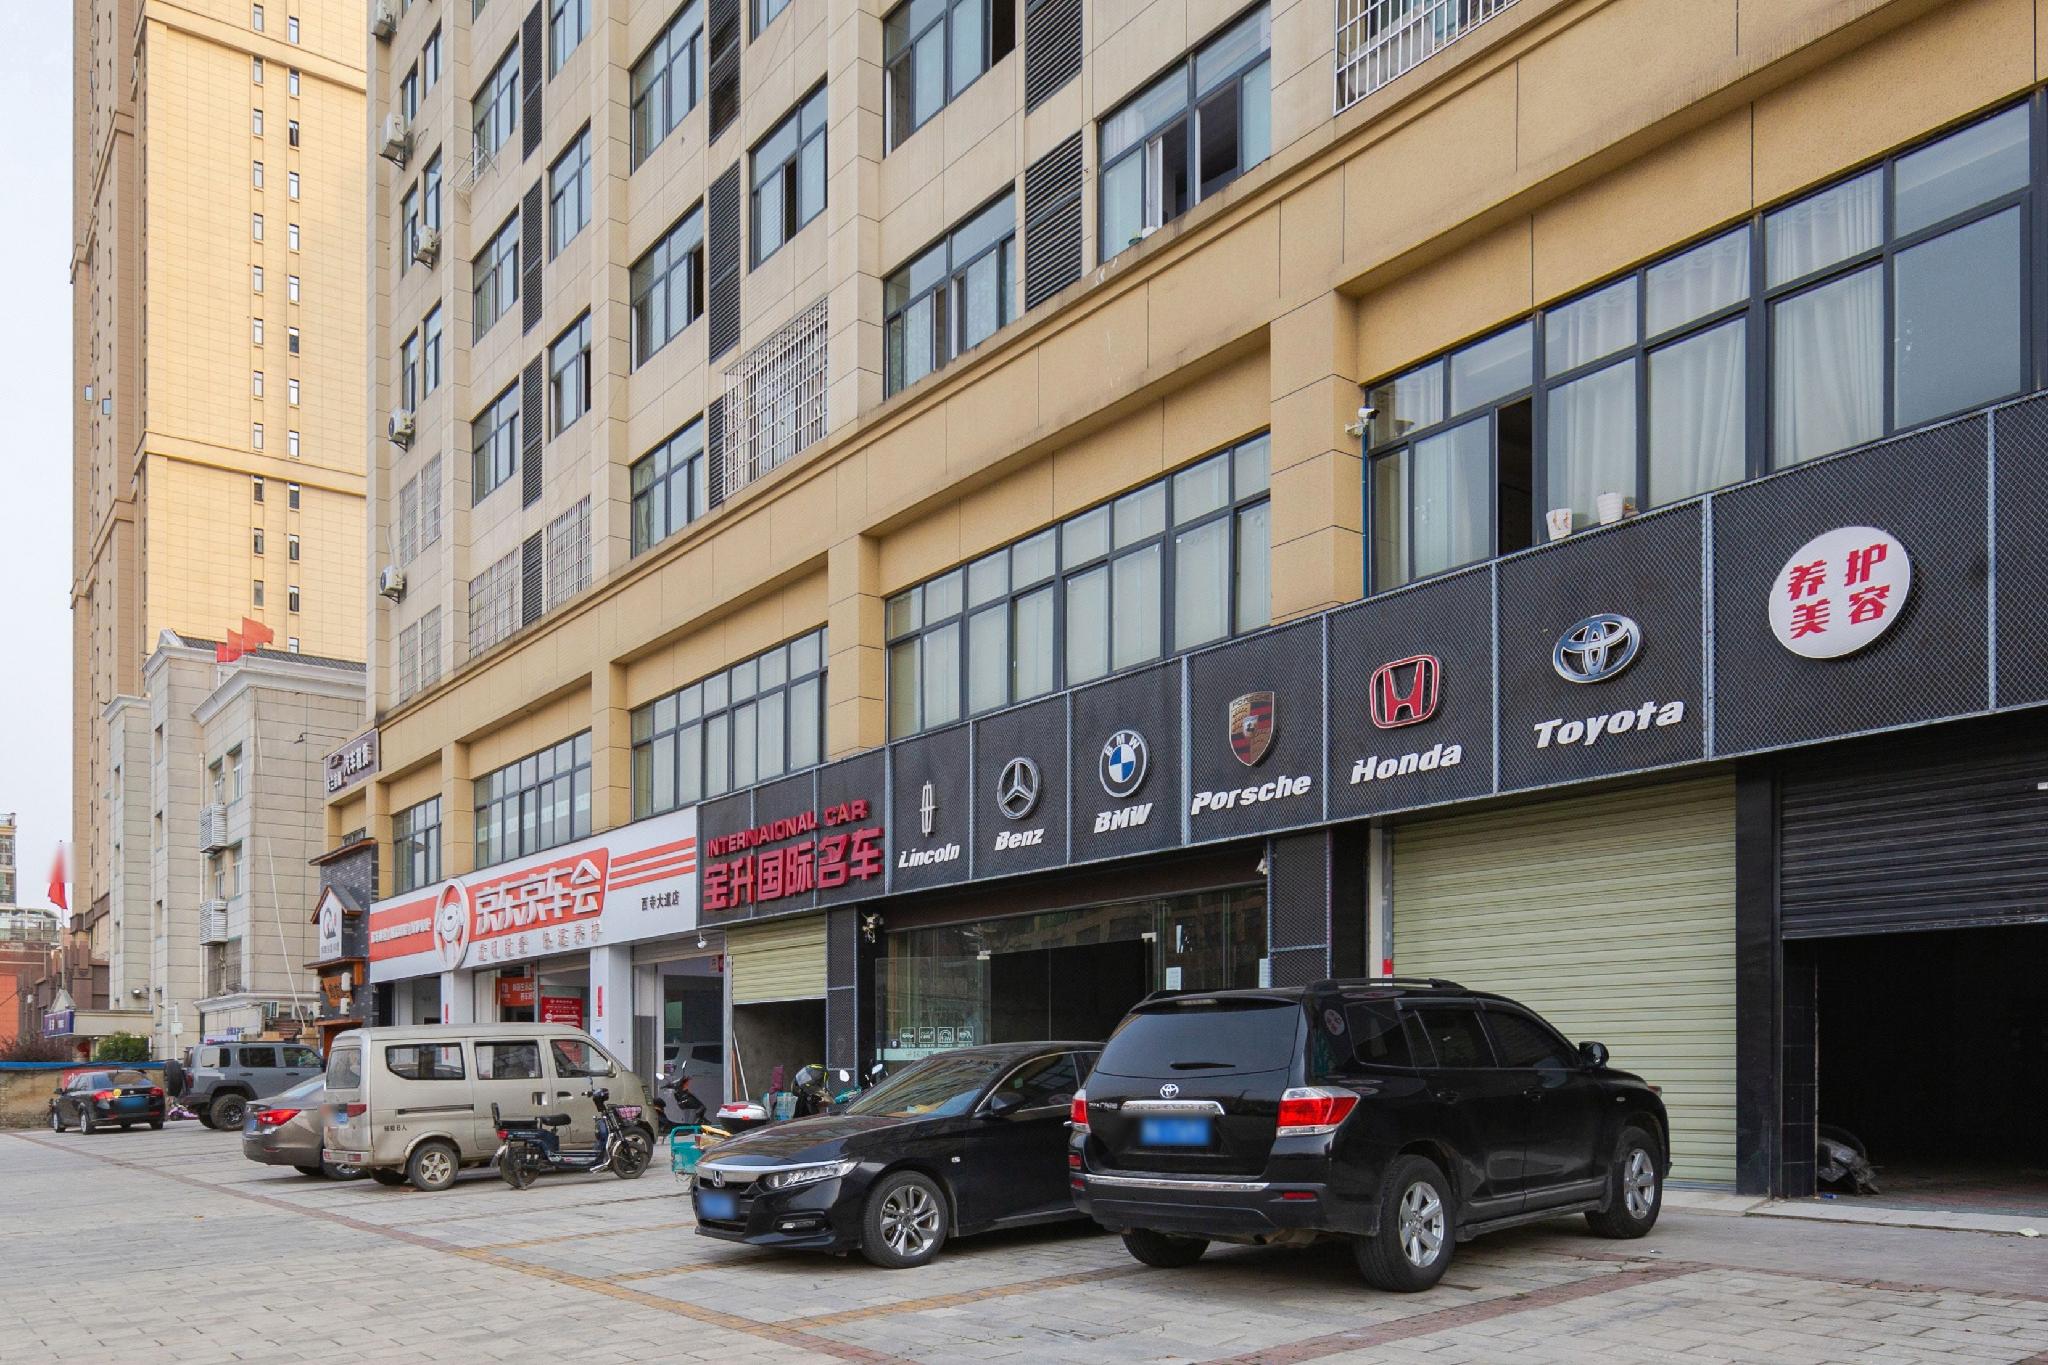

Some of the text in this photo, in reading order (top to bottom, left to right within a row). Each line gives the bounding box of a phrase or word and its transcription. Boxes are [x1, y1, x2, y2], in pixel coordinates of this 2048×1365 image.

[1788, 544, 1888, 601] 养护
[1789, 585, 1890, 640] 美容
[1105, 734, 1140, 756] BMW
[1534, 701, 1684, 748] Toyota
[1350, 744, 1462, 784] Honda
[1191, 775, 1311, 815] Porsche
[707, 799, 868, 857] INTERNAIONAL CAR
[995, 829, 1045, 850] Benz
[1094, 803, 1153, 833] BMW
[703, 827, 883, 911] 宝升国际名车
[898, 843, 960, 868] Lincoln
[475, 859, 600, 935] 京东京车会
